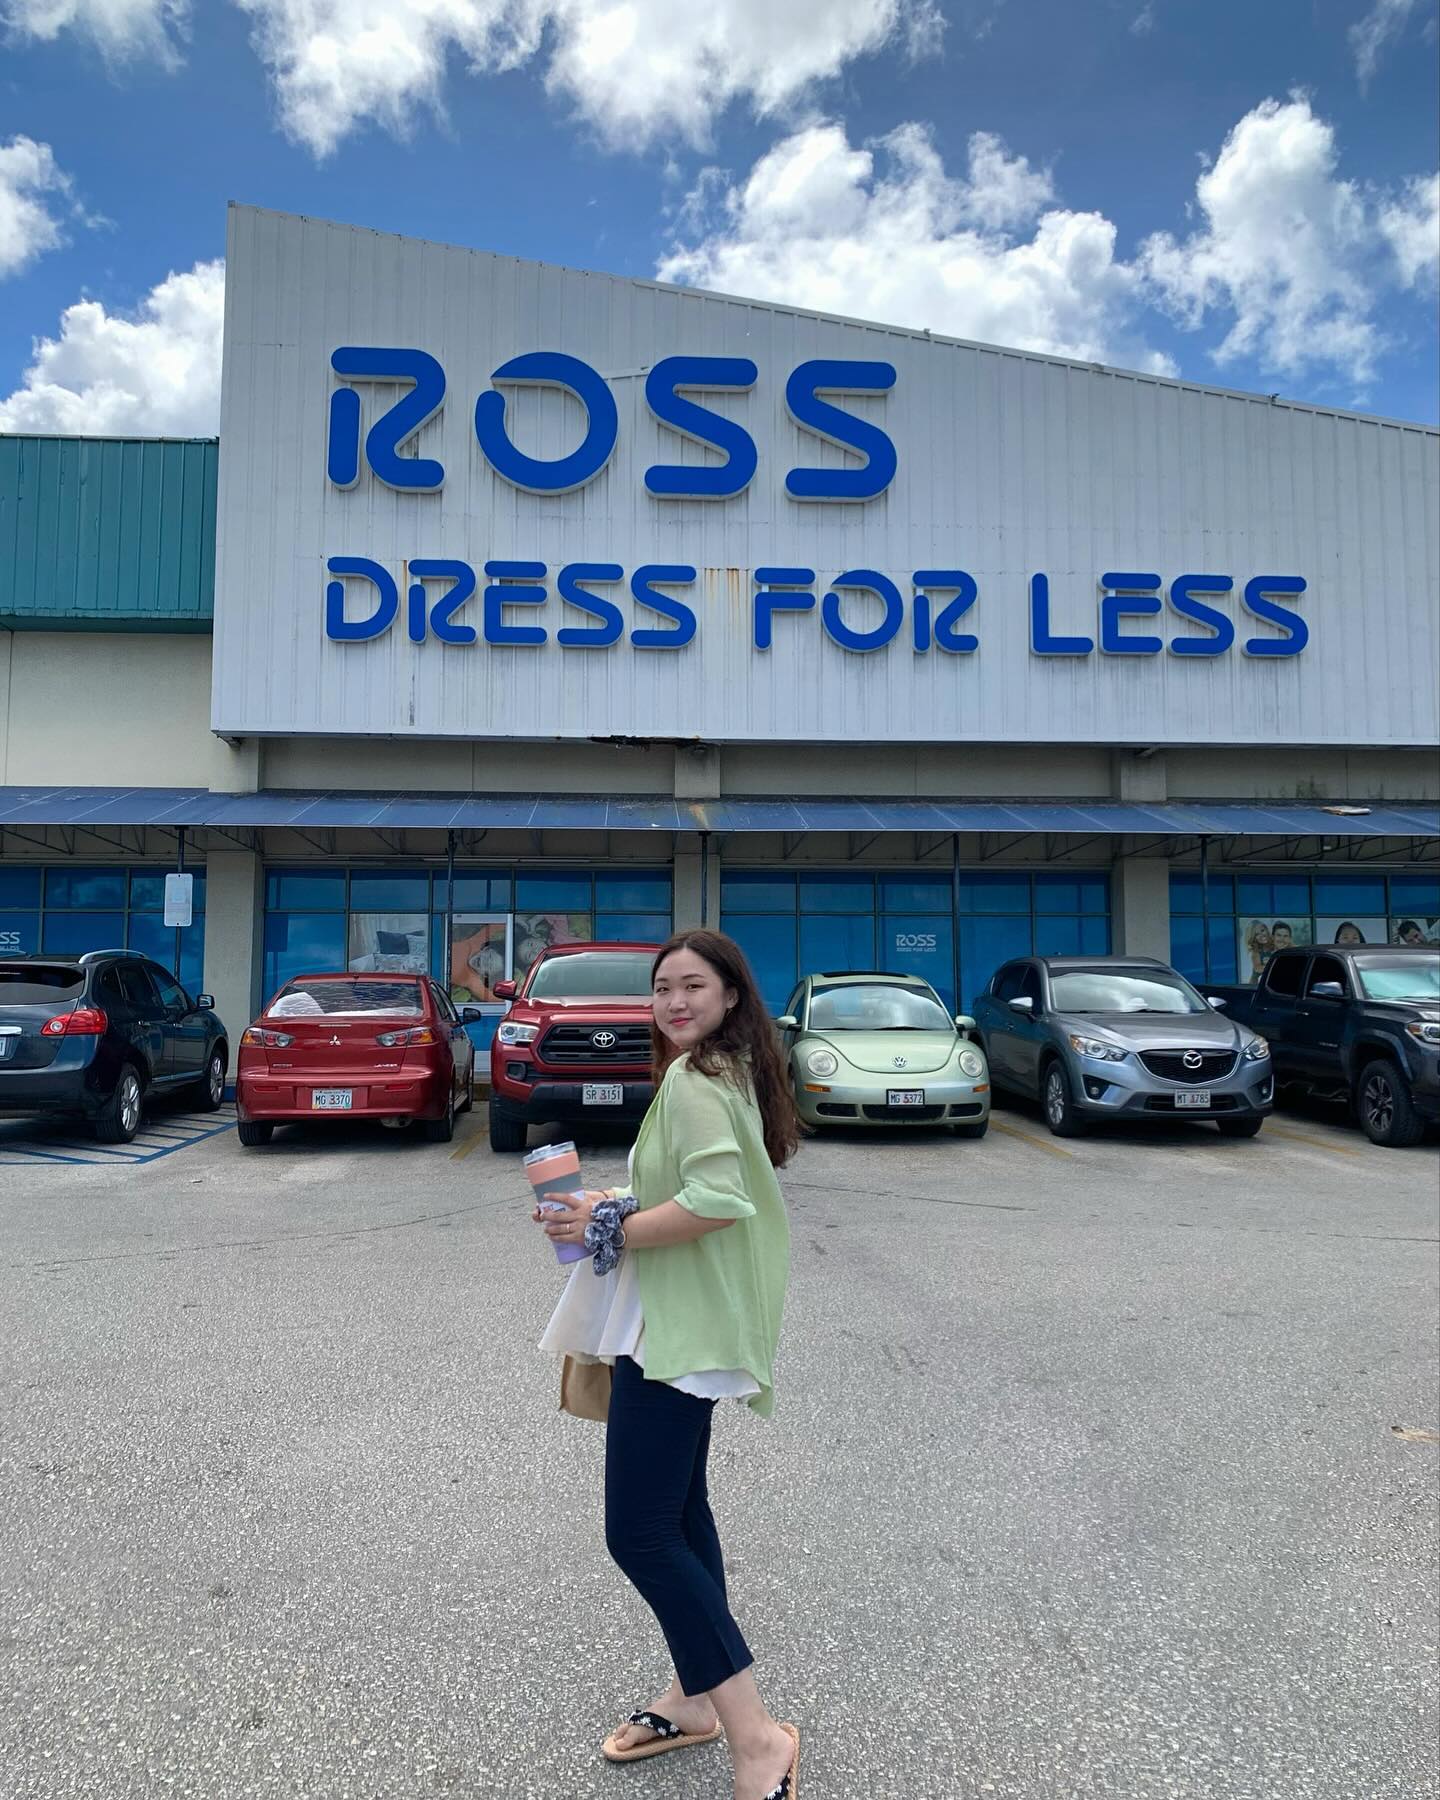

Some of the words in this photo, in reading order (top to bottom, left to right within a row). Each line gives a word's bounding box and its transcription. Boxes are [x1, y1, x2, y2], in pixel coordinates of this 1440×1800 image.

[328, 346, 898, 501] ROSS
[326, 556, 697, 648] DRESS
[754, 567, 979, 654] FOR
[1031, 572, 1309, 657] LESS
[896, 934, 937, 946] ROSS
[315, 1095, 326, 1105] MG
